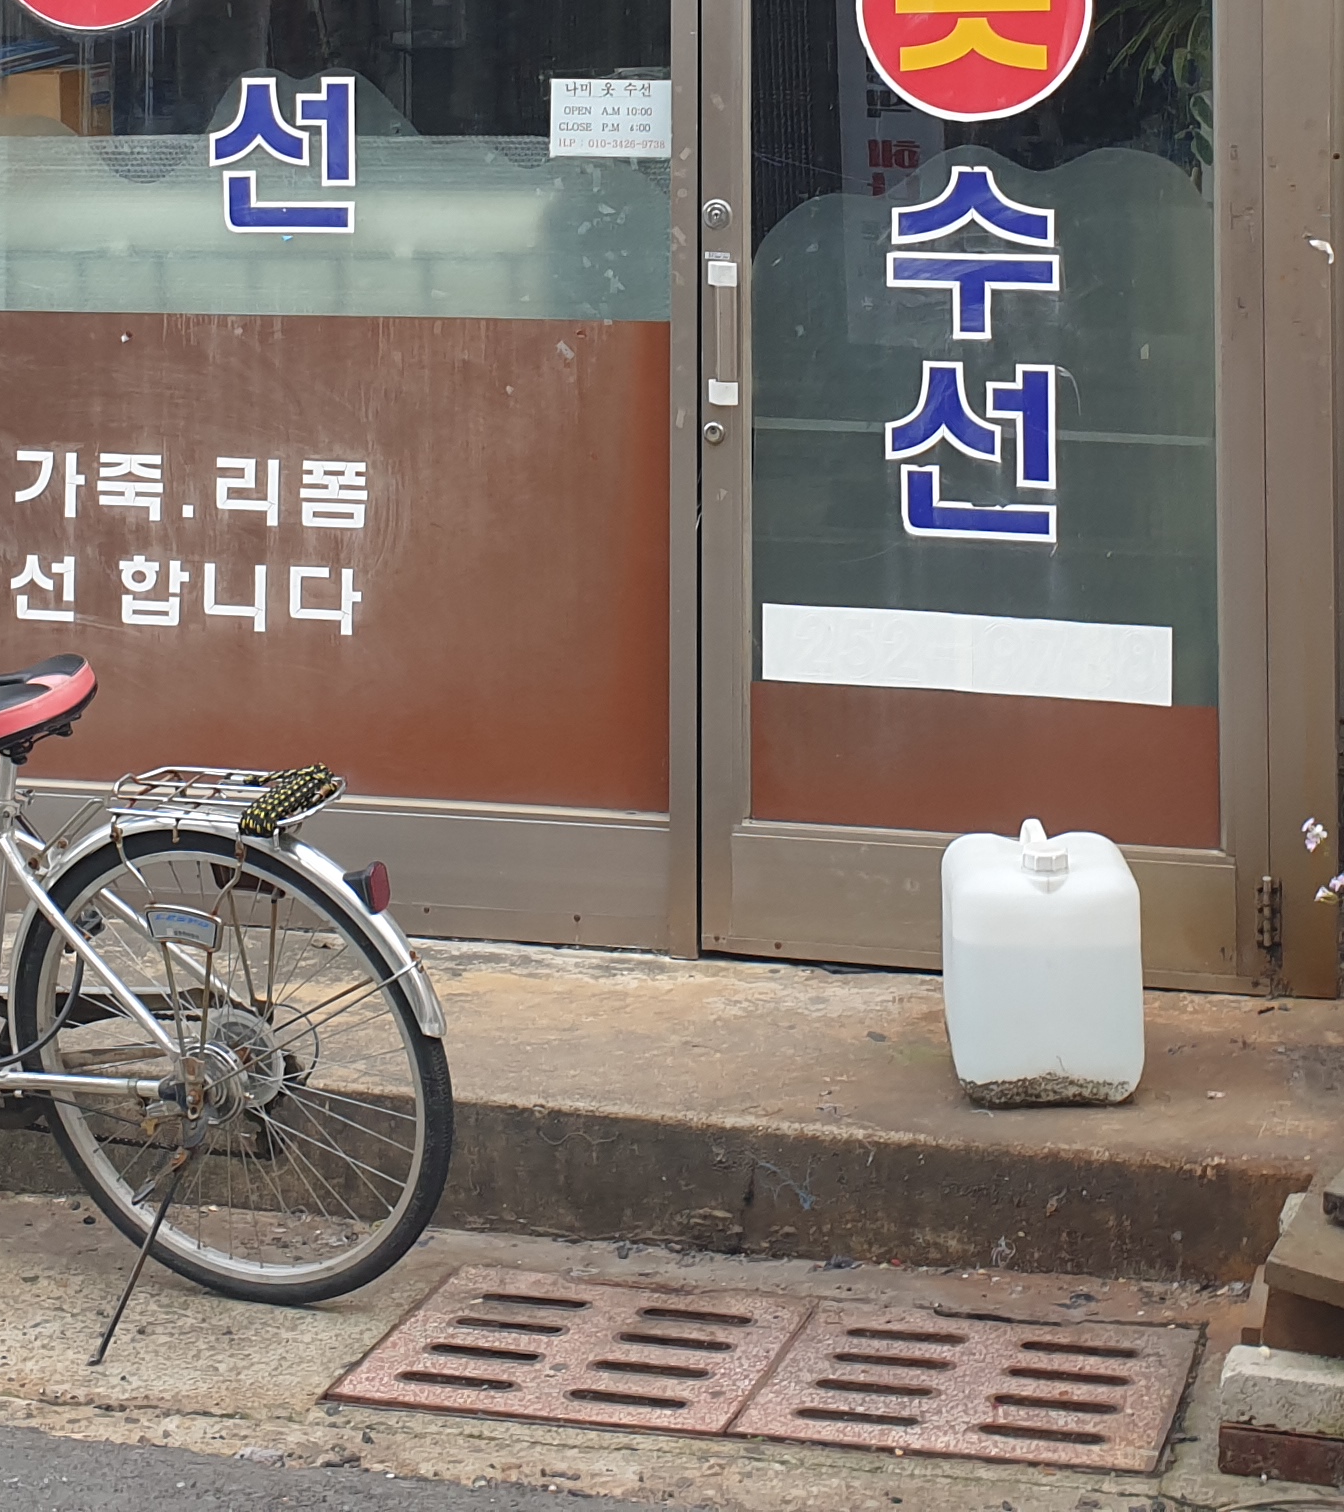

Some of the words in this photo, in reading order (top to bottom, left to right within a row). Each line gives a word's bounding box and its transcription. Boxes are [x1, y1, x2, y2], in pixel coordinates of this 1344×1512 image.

[624, 82, 651, 97] 수선
[563, 106, 592, 116] OPEN
[626, 107, 653, 117] 10:00
[558, 122, 592, 132] CLOSE
[885, 166, 1059, 543] 수선
[119, 554, 362, 635] 합니다
